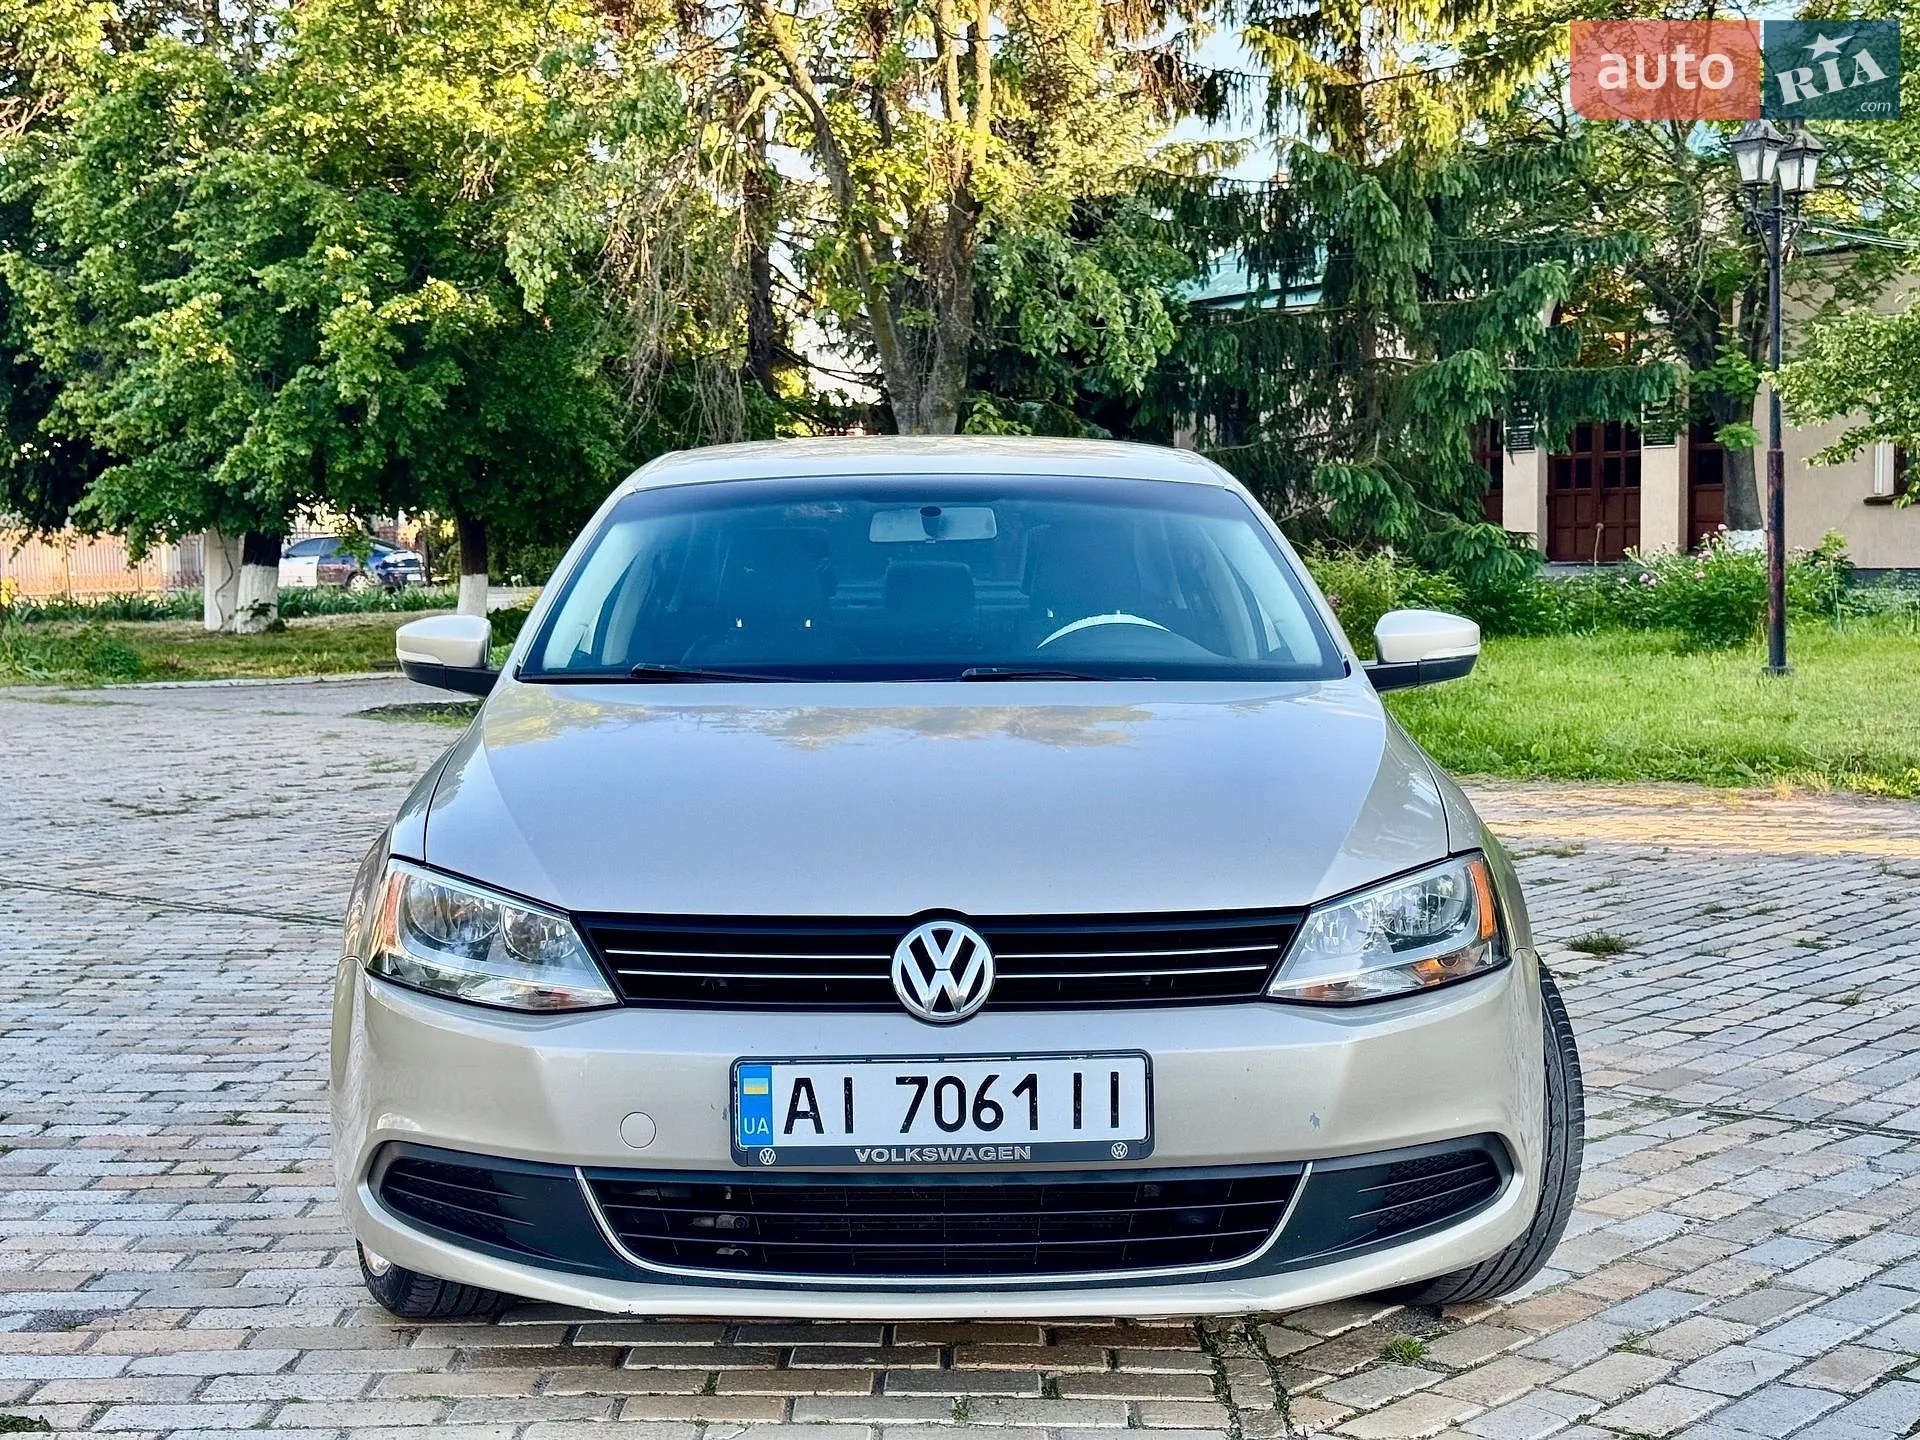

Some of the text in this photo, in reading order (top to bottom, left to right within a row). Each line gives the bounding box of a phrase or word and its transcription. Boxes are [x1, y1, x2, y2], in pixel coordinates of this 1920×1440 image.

[783, 1071, 1120, 1135] AI 7061 II
[743, 1116, 770, 1135] UA
[855, 1146, 1032, 1163] VOLKSWAGEN
